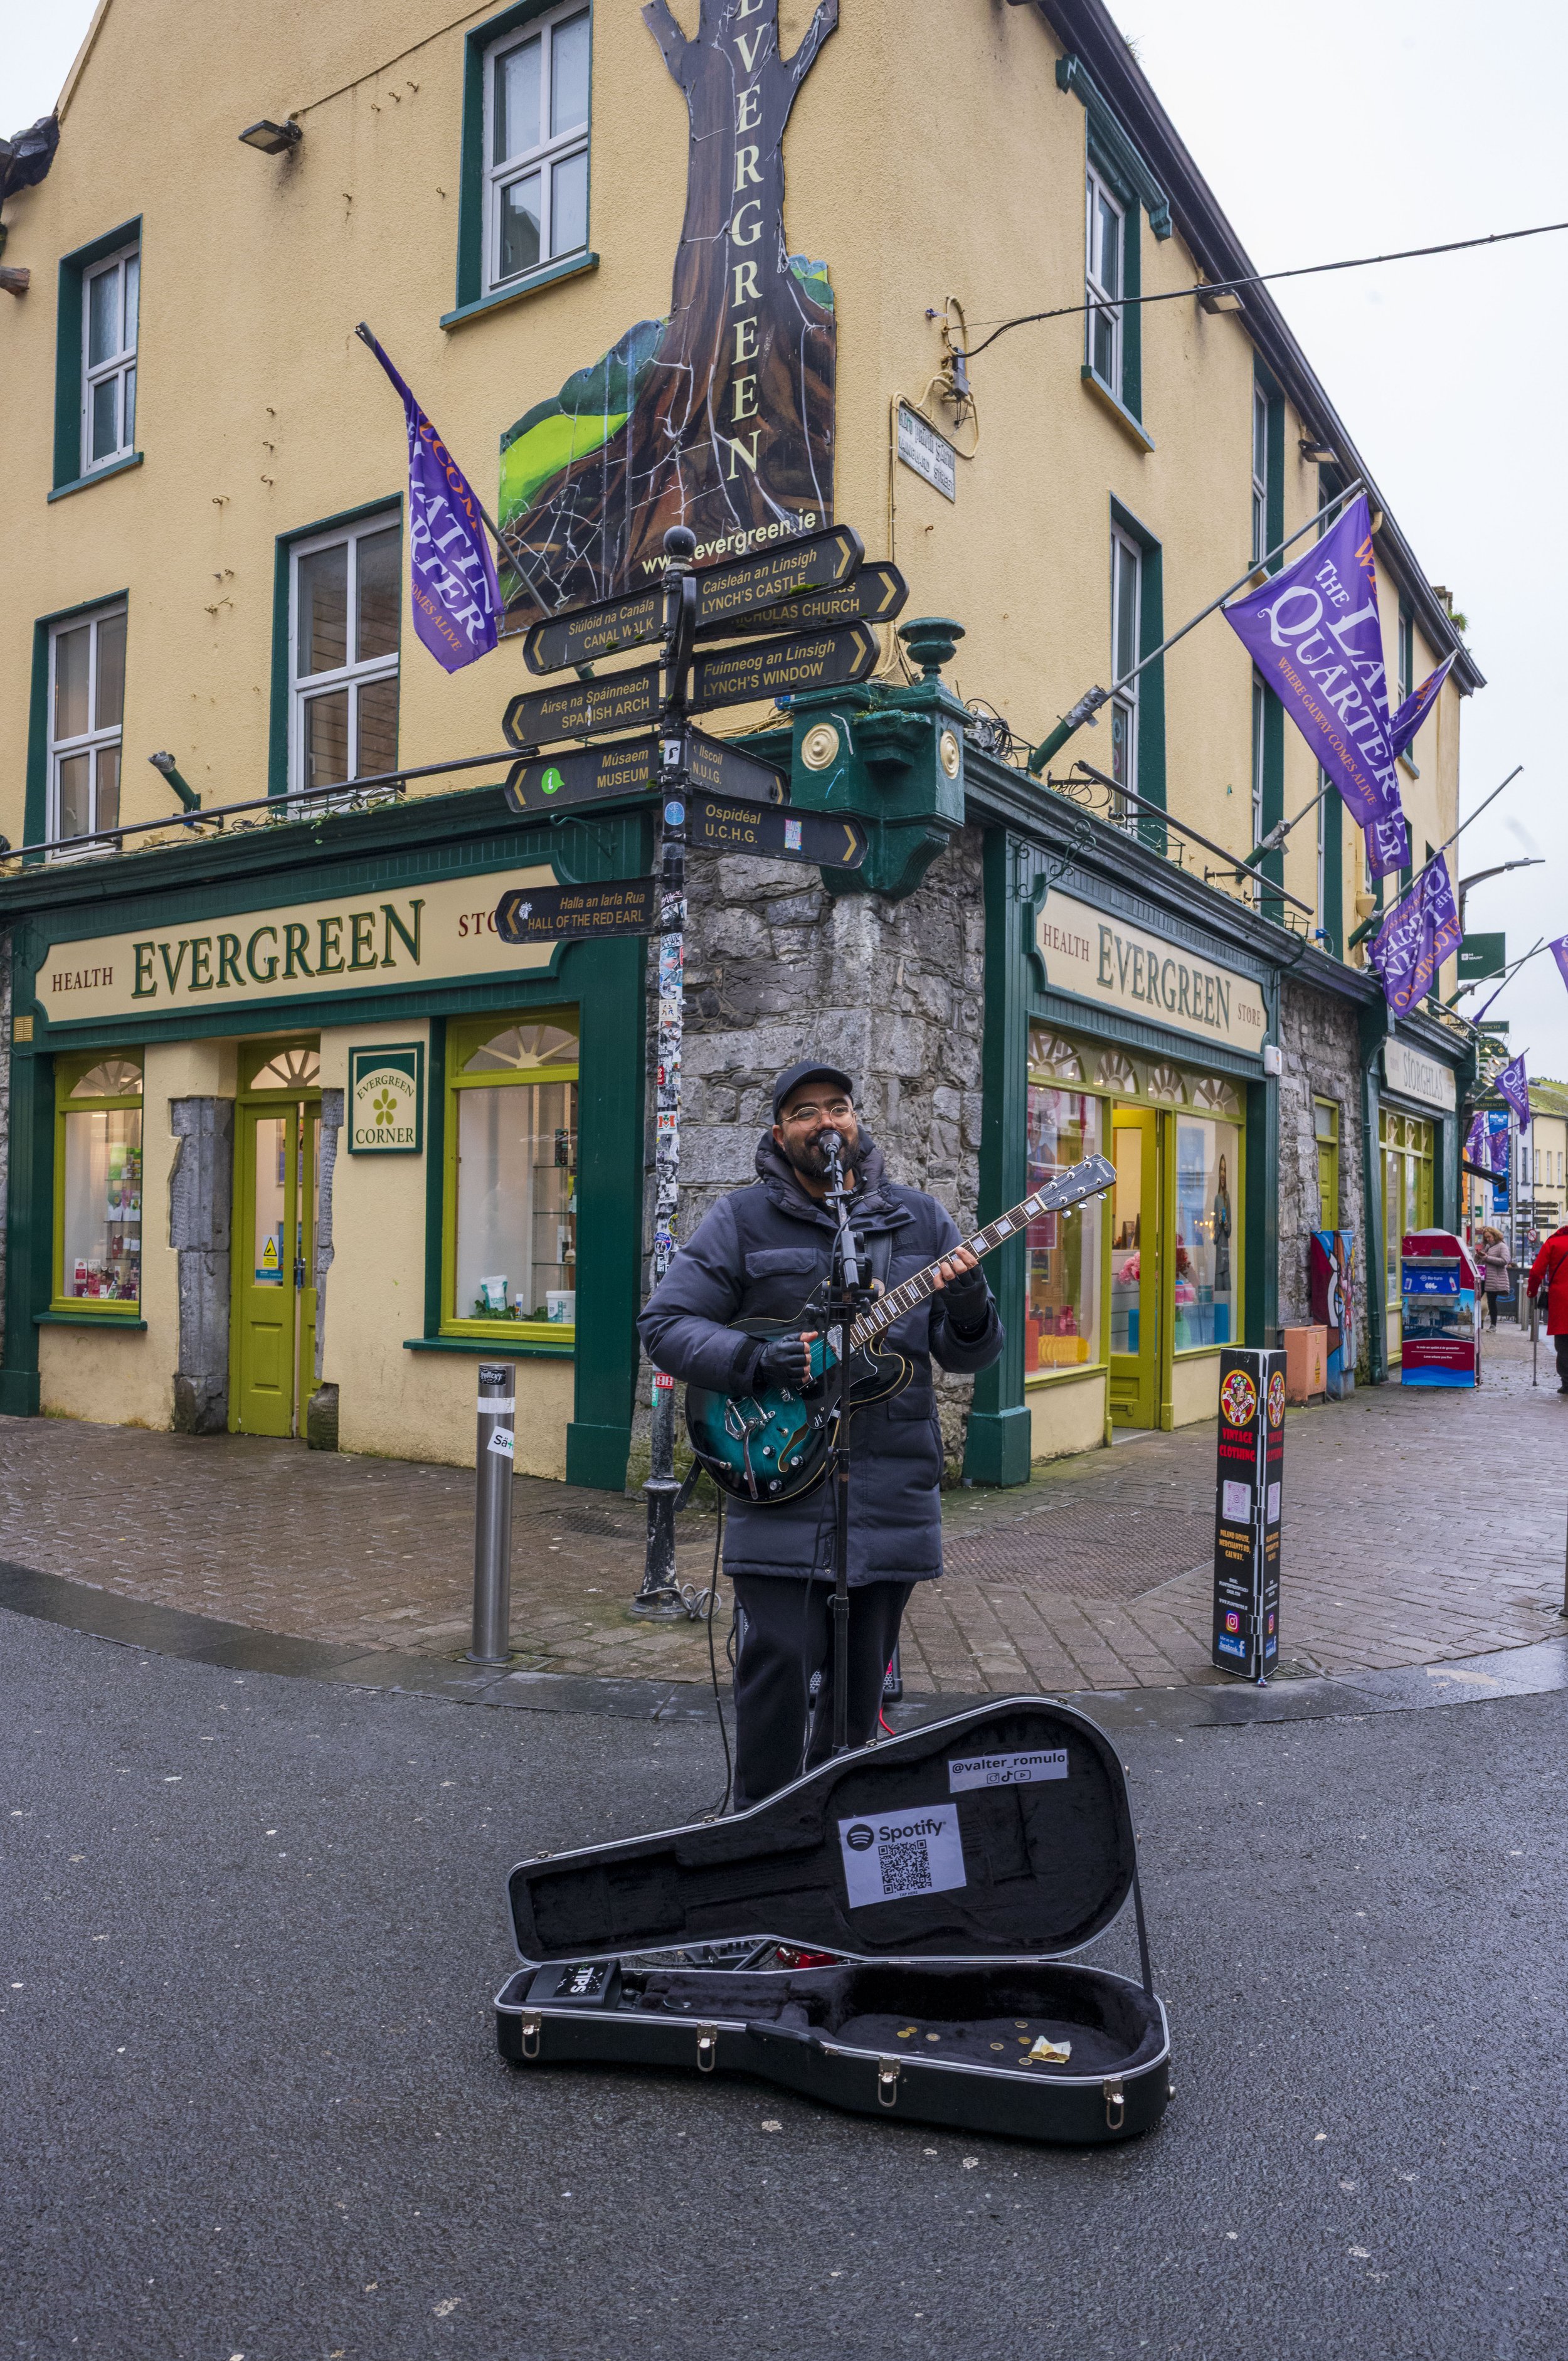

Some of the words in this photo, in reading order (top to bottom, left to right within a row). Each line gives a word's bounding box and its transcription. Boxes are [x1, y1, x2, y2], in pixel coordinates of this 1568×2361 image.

[642, 508, 816, 575] ww.evergreen.ie
[702, 570, 751, 595] Caisleán
[754, 565, 768, 580] an
[772, 548, 817, 573] Linsigh
[1315, 559, 1350, 608] THE
[756, 571, 806, 598] CASTLE
[568, 612, 602, 635] Siúlóid
[620, 599, 654, 620] Canála
[802, 598, 860, 617] CHURCH
[432, 615, 462, 652] ALIVE
[584, 628, 620, 649] CANAL
[704, 656, 763, 677] Fuinneog
[766, 652, 782, 665] an
[786, 639, 835, 661] Linsigh
[763, 662, 824, 686] WINDOW
[540, 699, 567, 715] Áirse
[570, 695, 583, 708] na
[586, 677, 649, 706] Spáinneach
[1258, 585, 1397, 802] QUARTER
[562, 705, 612, 729] SPANISH
[615, 696, 650, 716] ARCH
[1278, 656, 1306, 697] WHERE
[1302, 694, 1334, 734] GALWAY
[1328, 730, 1358, 773] COMES
[1351, 770, 1377, 806] ALIVE
[601, 750, 649, 768] Músaem
[597, 767, 649, 788] MUSEUM
[692, 761, 721, 784] N.U.I.G.
[705, 804, 761, 825] Ospidéal
[705, 823, 758, 843] U.C.H.G.
[559, 897, 584, 910] Halla
[586, 897, 598, 908] an
[625, 891, 645, 905] Rua
[528, 917, 553, 930] HALL
[556, 915, 569, 928] OF
[572, 914, 590, 927] THE
[593, 911, 613, 926] RED
[615, 910, 644, 924] EARL
[51, 966, 114, 993] HEALTH
[132, 899, 425, 999] EVERGREEN
[458, 910, 499, 936] STO
[1043, 923, 1089, 962] HEALTH
[1096, 923, 1231, 1032] EVERGREEN
[1237, 1004, 1261, 1027] STORE
[357, 1074, 414, 1100] EVERGREEN
[356, 1128, 414, 1144] CORNER
[1222, 1427, 1253, 1444] VINTAGE
[1219, 1445, 1256, 1462] CLOTHING
[1220, 1641, 1238, 1652] facebook
[952, 1753, 1065, 1773] @valter_romulo
[879, 1819, 942, 1843] Spotify
[570, 1967, 595, 1993] TIPS
